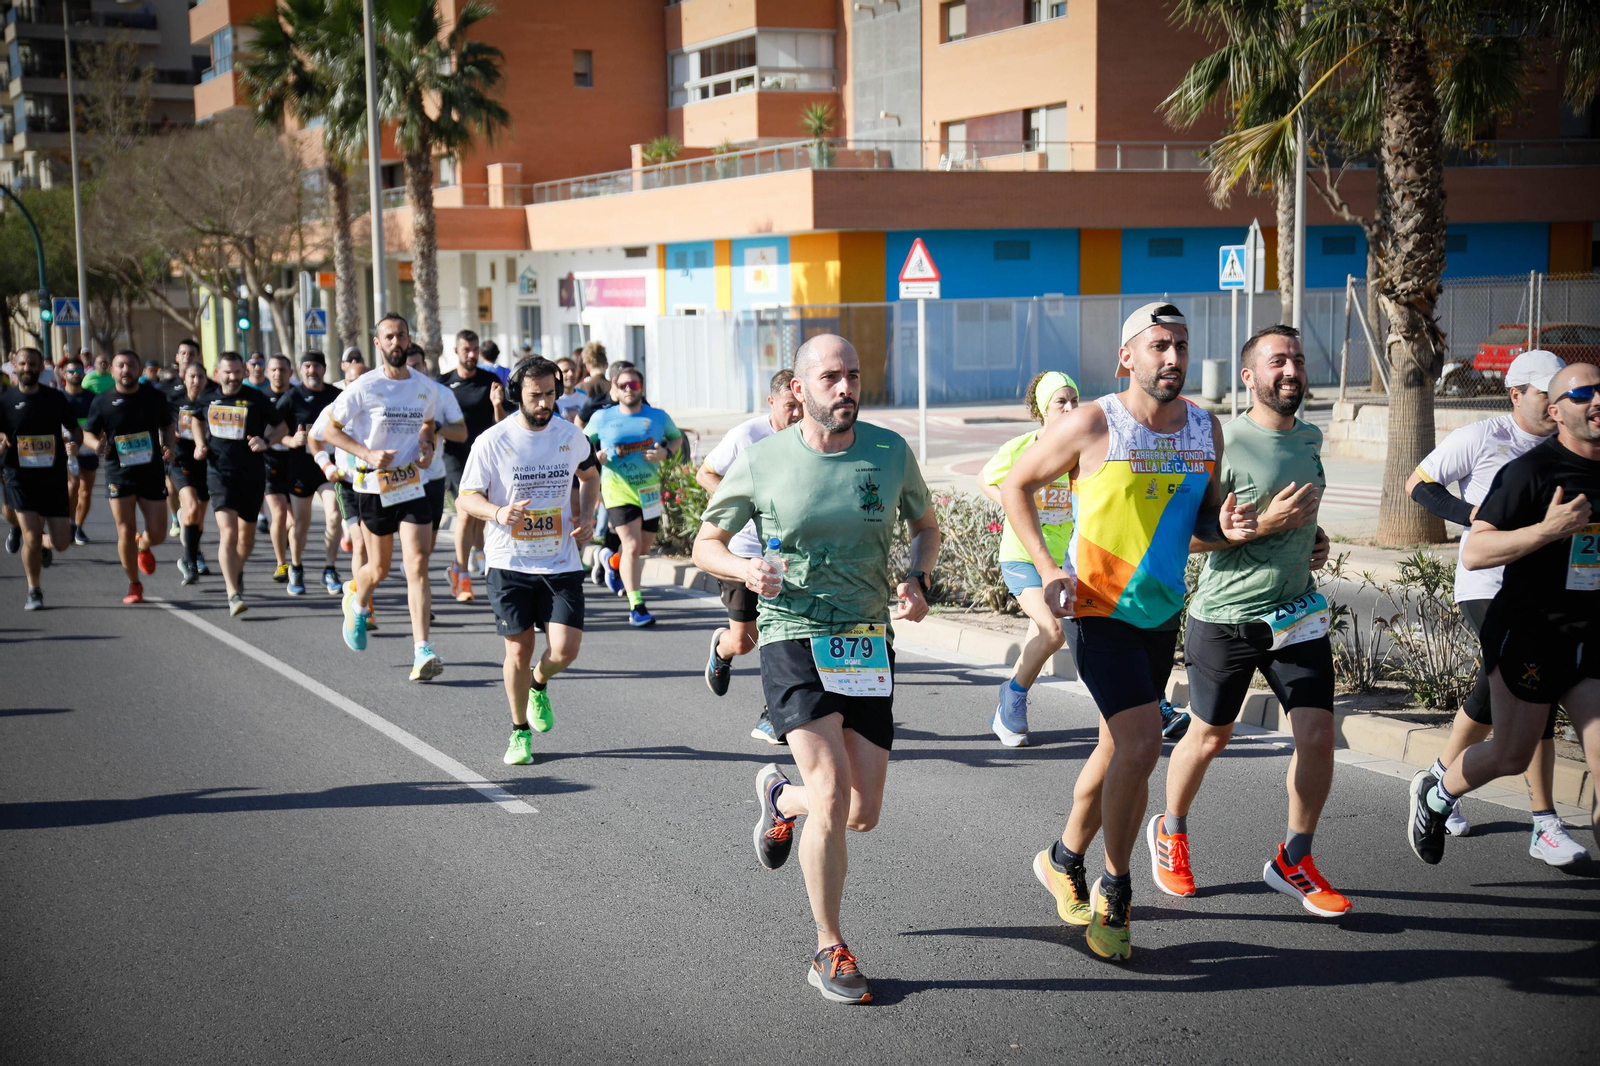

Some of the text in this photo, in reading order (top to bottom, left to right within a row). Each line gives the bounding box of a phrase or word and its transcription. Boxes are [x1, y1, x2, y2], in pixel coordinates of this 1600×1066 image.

[213, 411, 241, 421] 2119
[23, 441, 51, 450] 2130
[121, 438, 147, 450] 2135
[1158, 440, 1174, 450] XXX
[1129, 450, 1204, 460] CARRERA DE FONDO
[513, 463, 569, 473] Medio Maratón
[1130, 461, 1204, 472] VILLA DE CAJAR
[383, 467, 416, 485] 1499
[513, 470, 570, 480] Almería 2024
[523, 516, 553, 531] 348
[829, 636, 874, 659] 879
